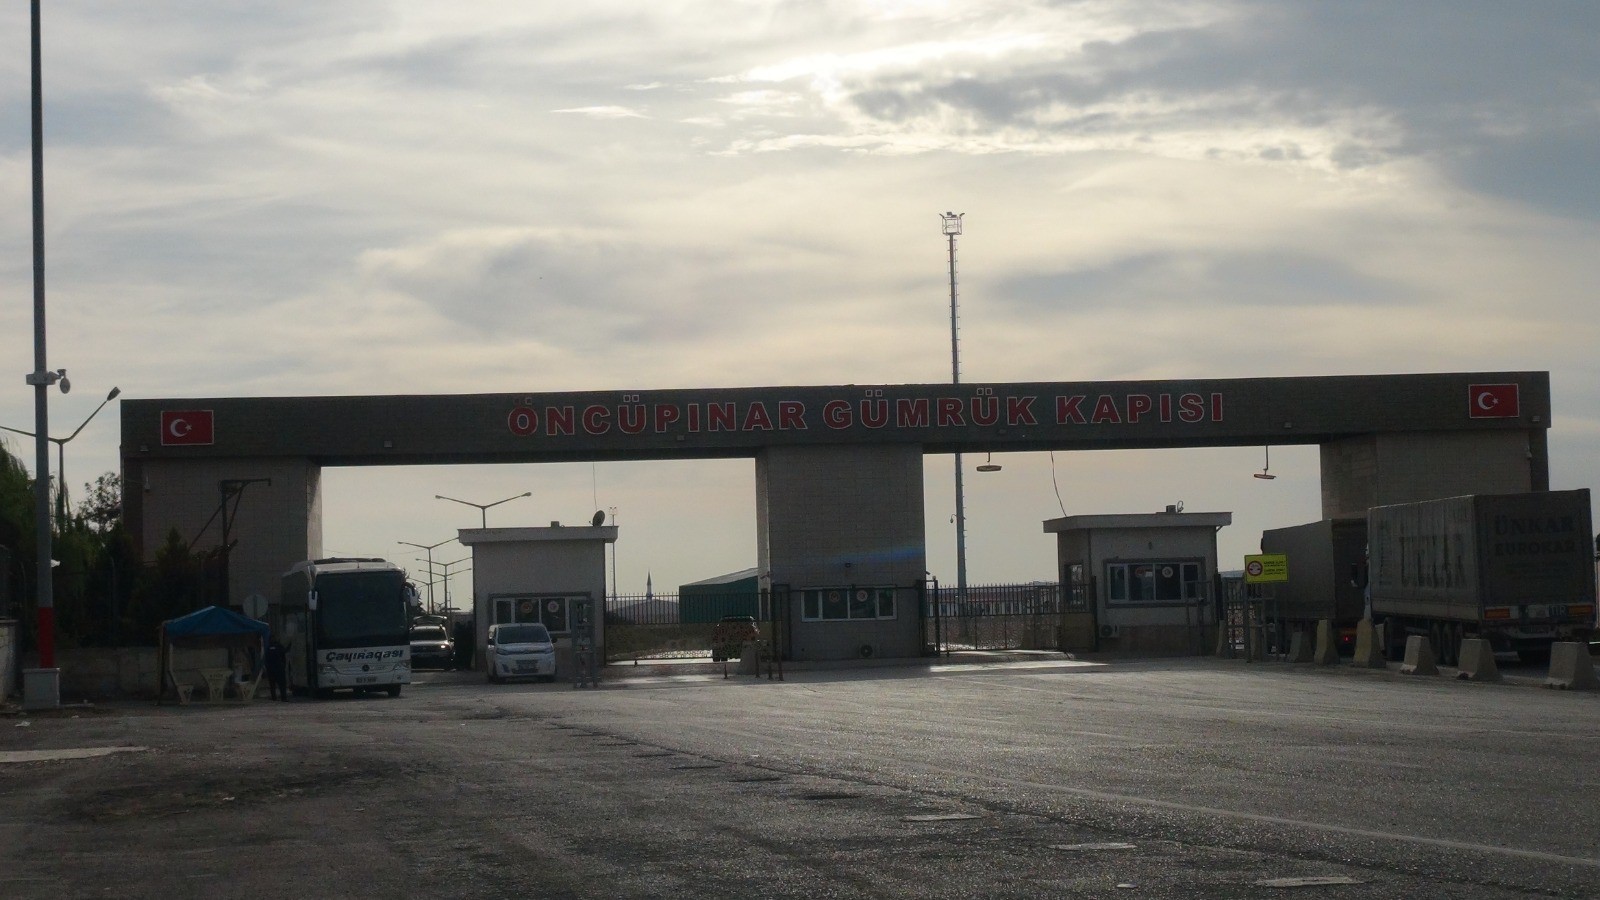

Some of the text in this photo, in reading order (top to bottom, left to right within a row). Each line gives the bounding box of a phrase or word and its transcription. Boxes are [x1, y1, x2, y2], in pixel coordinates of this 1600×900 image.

[508, 387, 1224, 436] ÖNCÜPINAR GÜMRÜK KAPISI
[1494, 539, 1577, 556] EUROKAR
